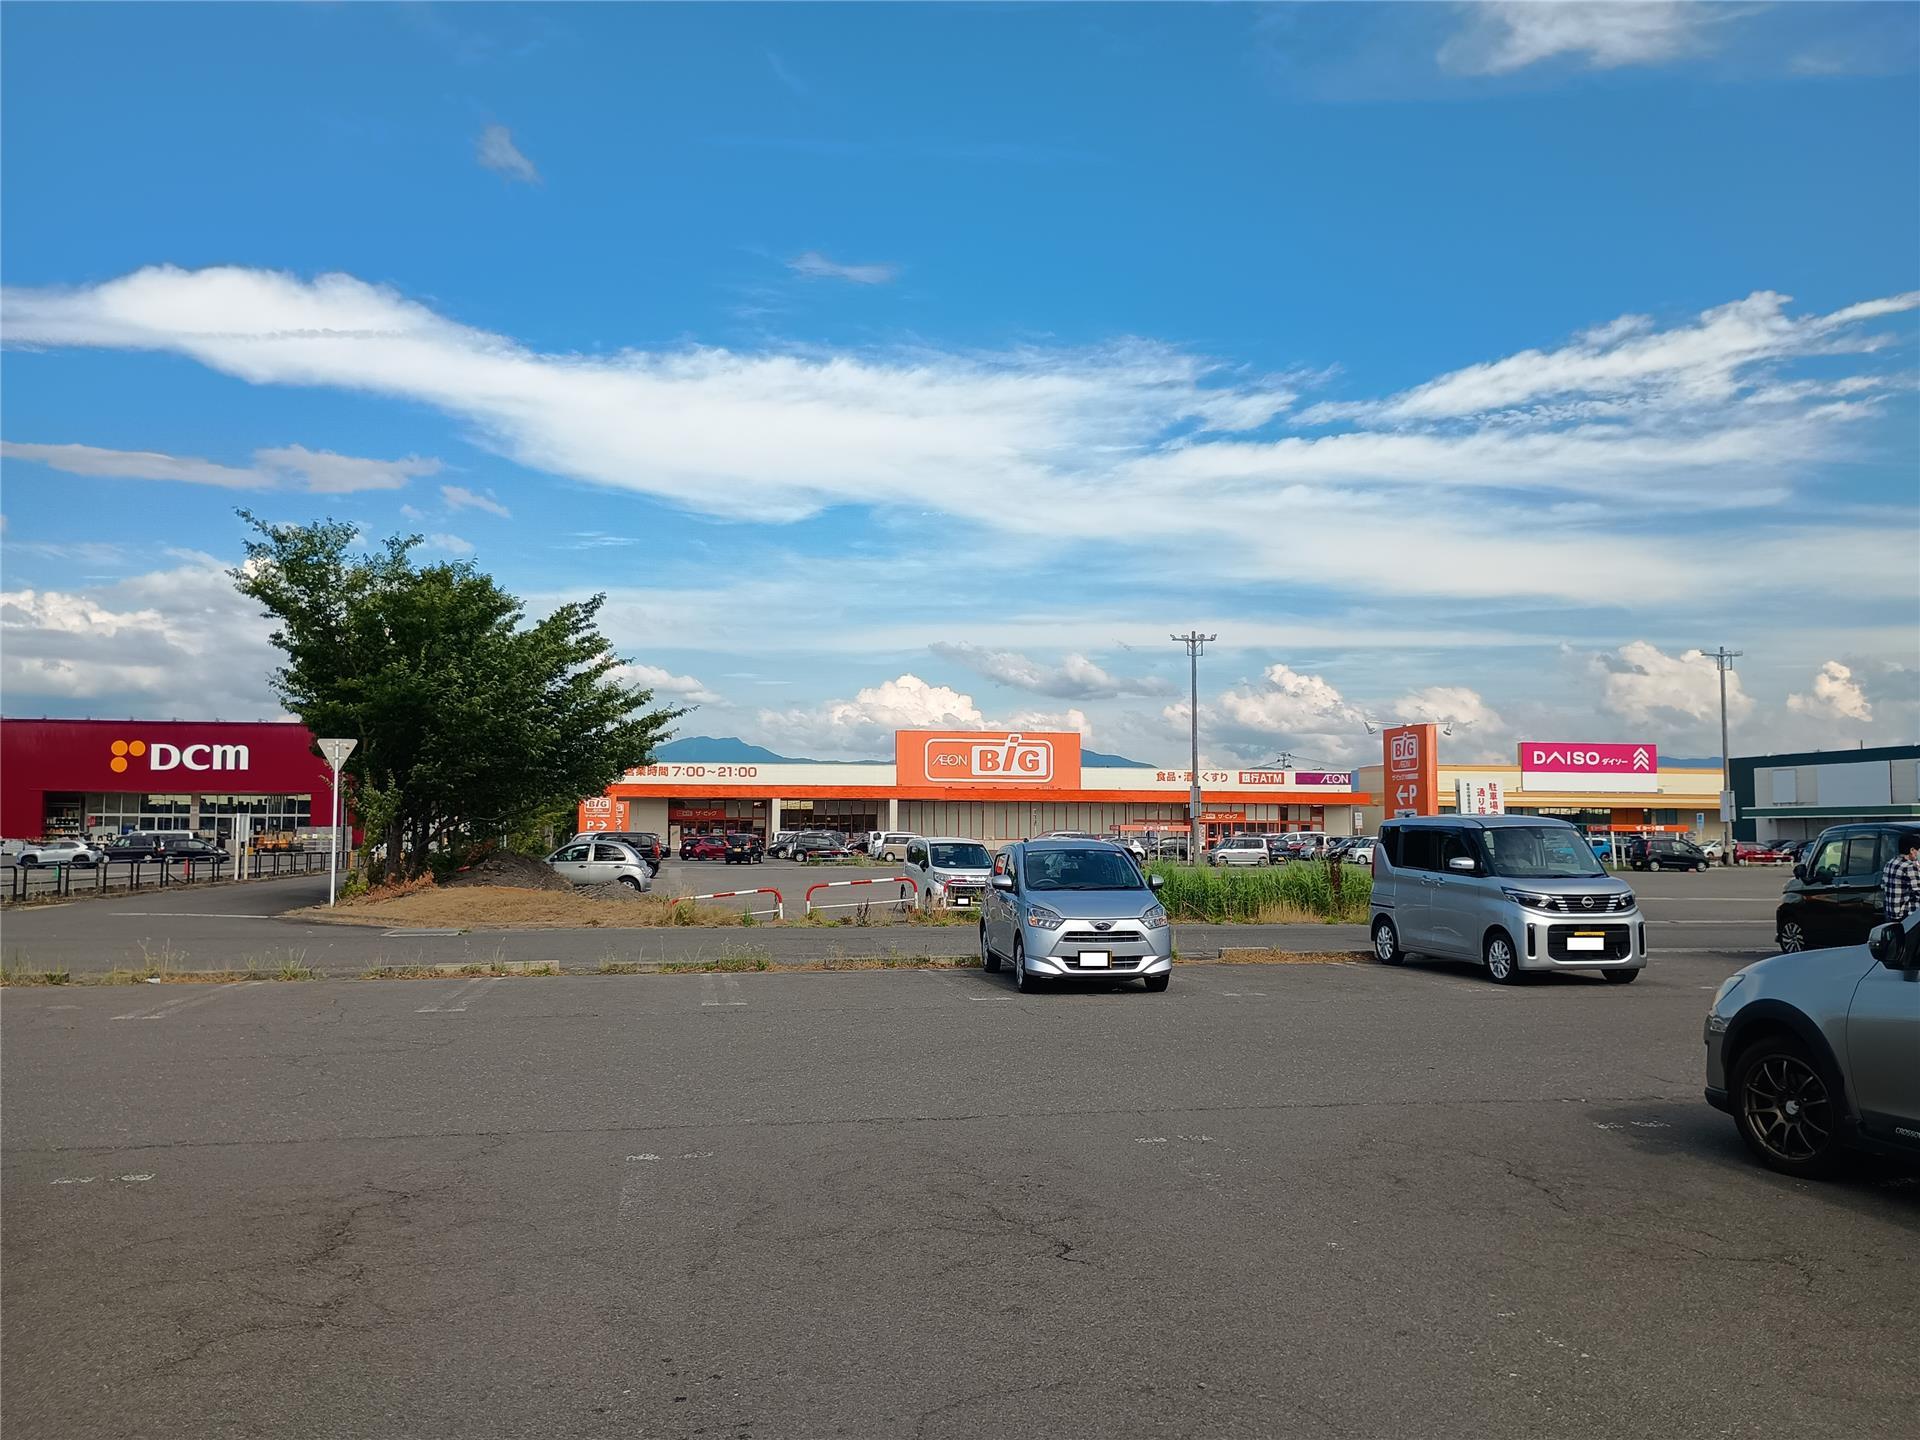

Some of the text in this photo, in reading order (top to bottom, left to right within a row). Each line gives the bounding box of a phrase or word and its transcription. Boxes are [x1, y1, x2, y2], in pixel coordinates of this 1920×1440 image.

[1533, 751, 1600, 765] DAISO
[1601, 757, 1629, 766] ダイソー
[1409, 784, 1417, 805] P
[587, 821, 595, 830] P
[1895, 1127, 1920, 1139] CROSSO
